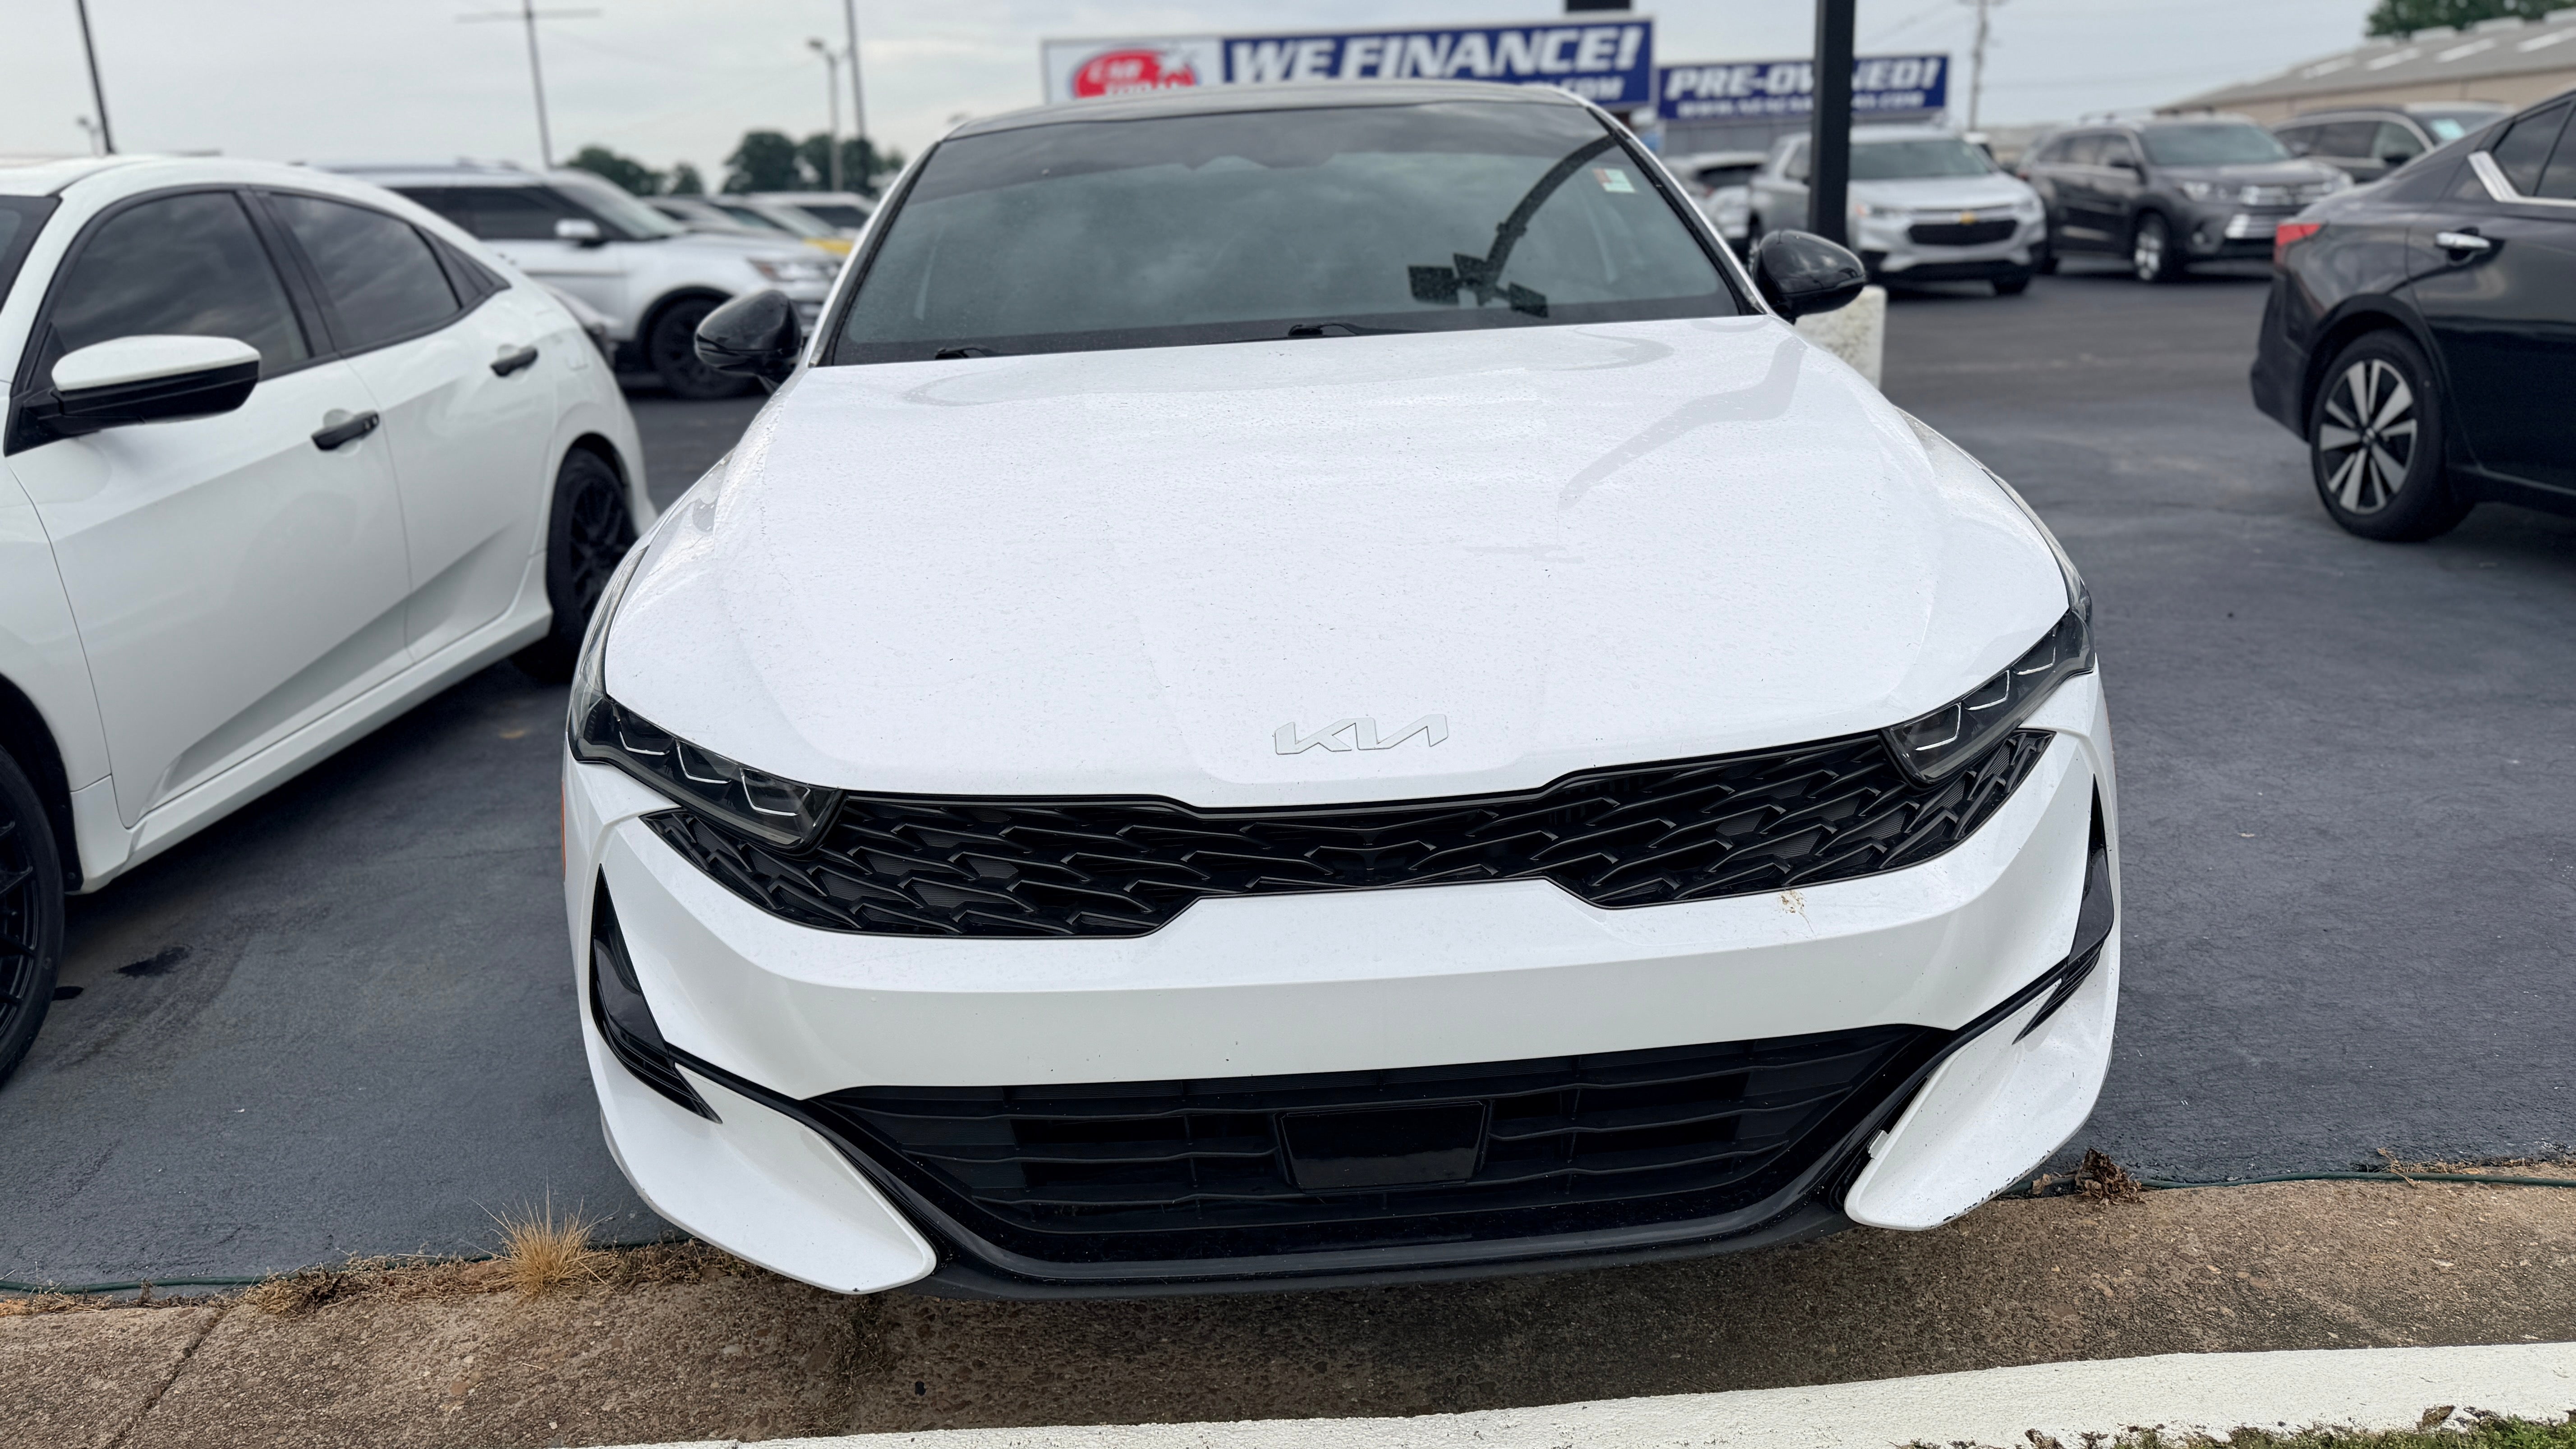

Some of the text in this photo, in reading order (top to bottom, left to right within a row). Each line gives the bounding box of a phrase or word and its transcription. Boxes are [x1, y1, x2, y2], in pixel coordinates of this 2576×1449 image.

[1231, 25, 1644, 82] WE FINANCE!
[1274, 714, 1449, 755] KIA
